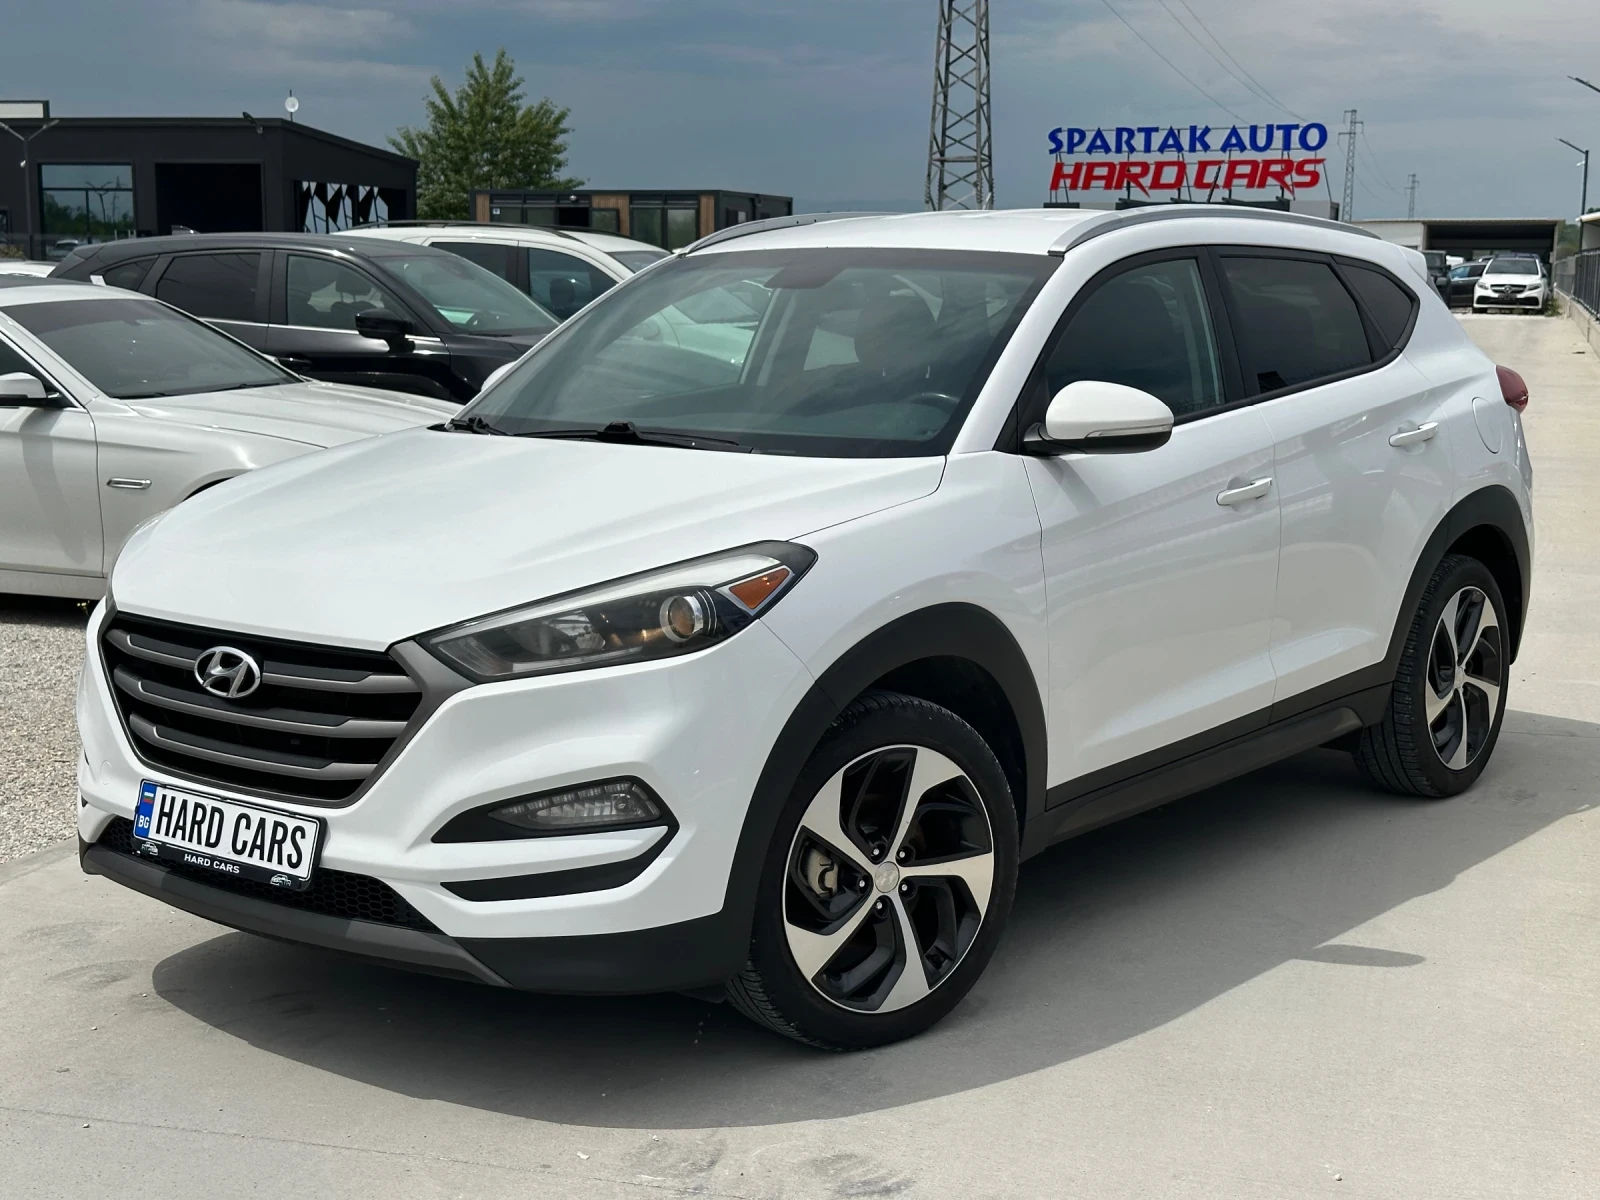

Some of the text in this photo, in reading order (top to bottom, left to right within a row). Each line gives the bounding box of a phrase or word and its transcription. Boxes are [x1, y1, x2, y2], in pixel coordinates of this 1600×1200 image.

[1048, 122, 1328, 155] SPARTAK AUTO
[1050, 158, 1326, 197] HARD CARS
[138, 815, 150, 829] BG
[155, 794, 306, 869] HARD CARS
[184, 853, 240, 874] HARD CARS
